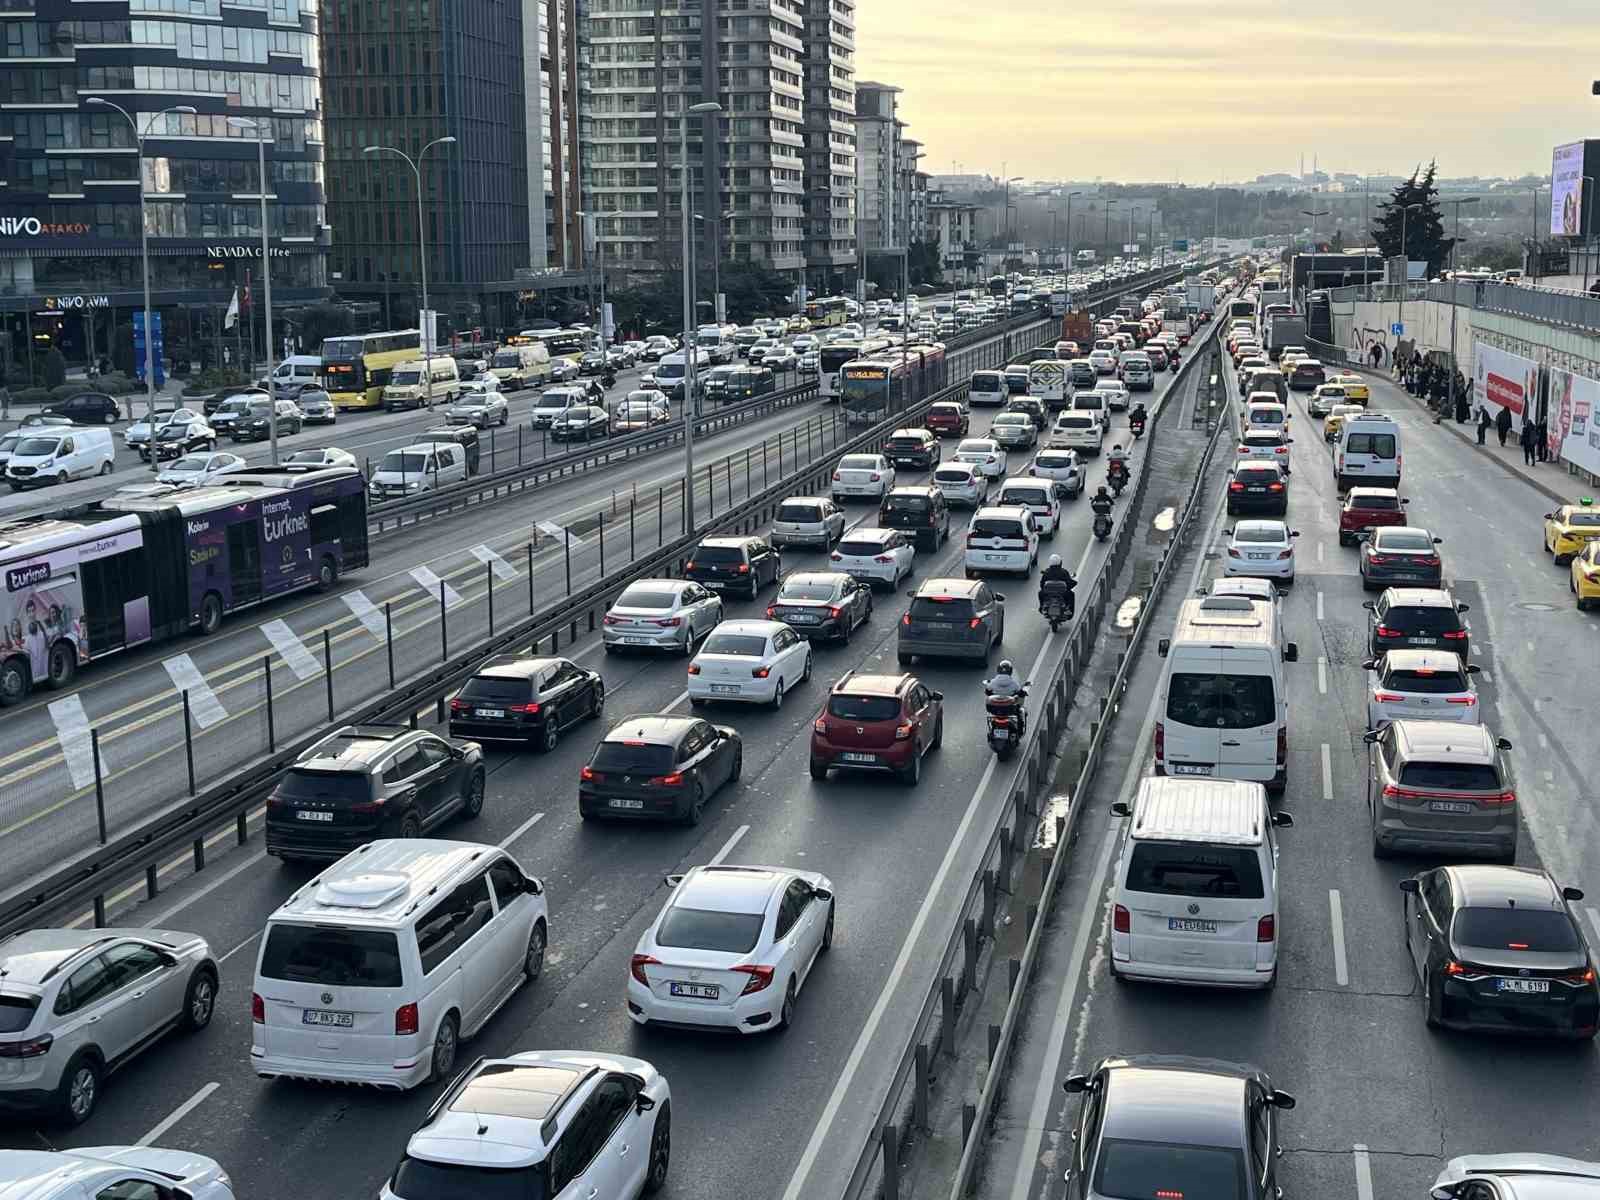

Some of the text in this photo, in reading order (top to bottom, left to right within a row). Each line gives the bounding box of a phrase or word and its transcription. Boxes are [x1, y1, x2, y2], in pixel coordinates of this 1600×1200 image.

[207, 246, 290, 257] NEVADA Cffee
[263, 513, 308, 542] turknet
